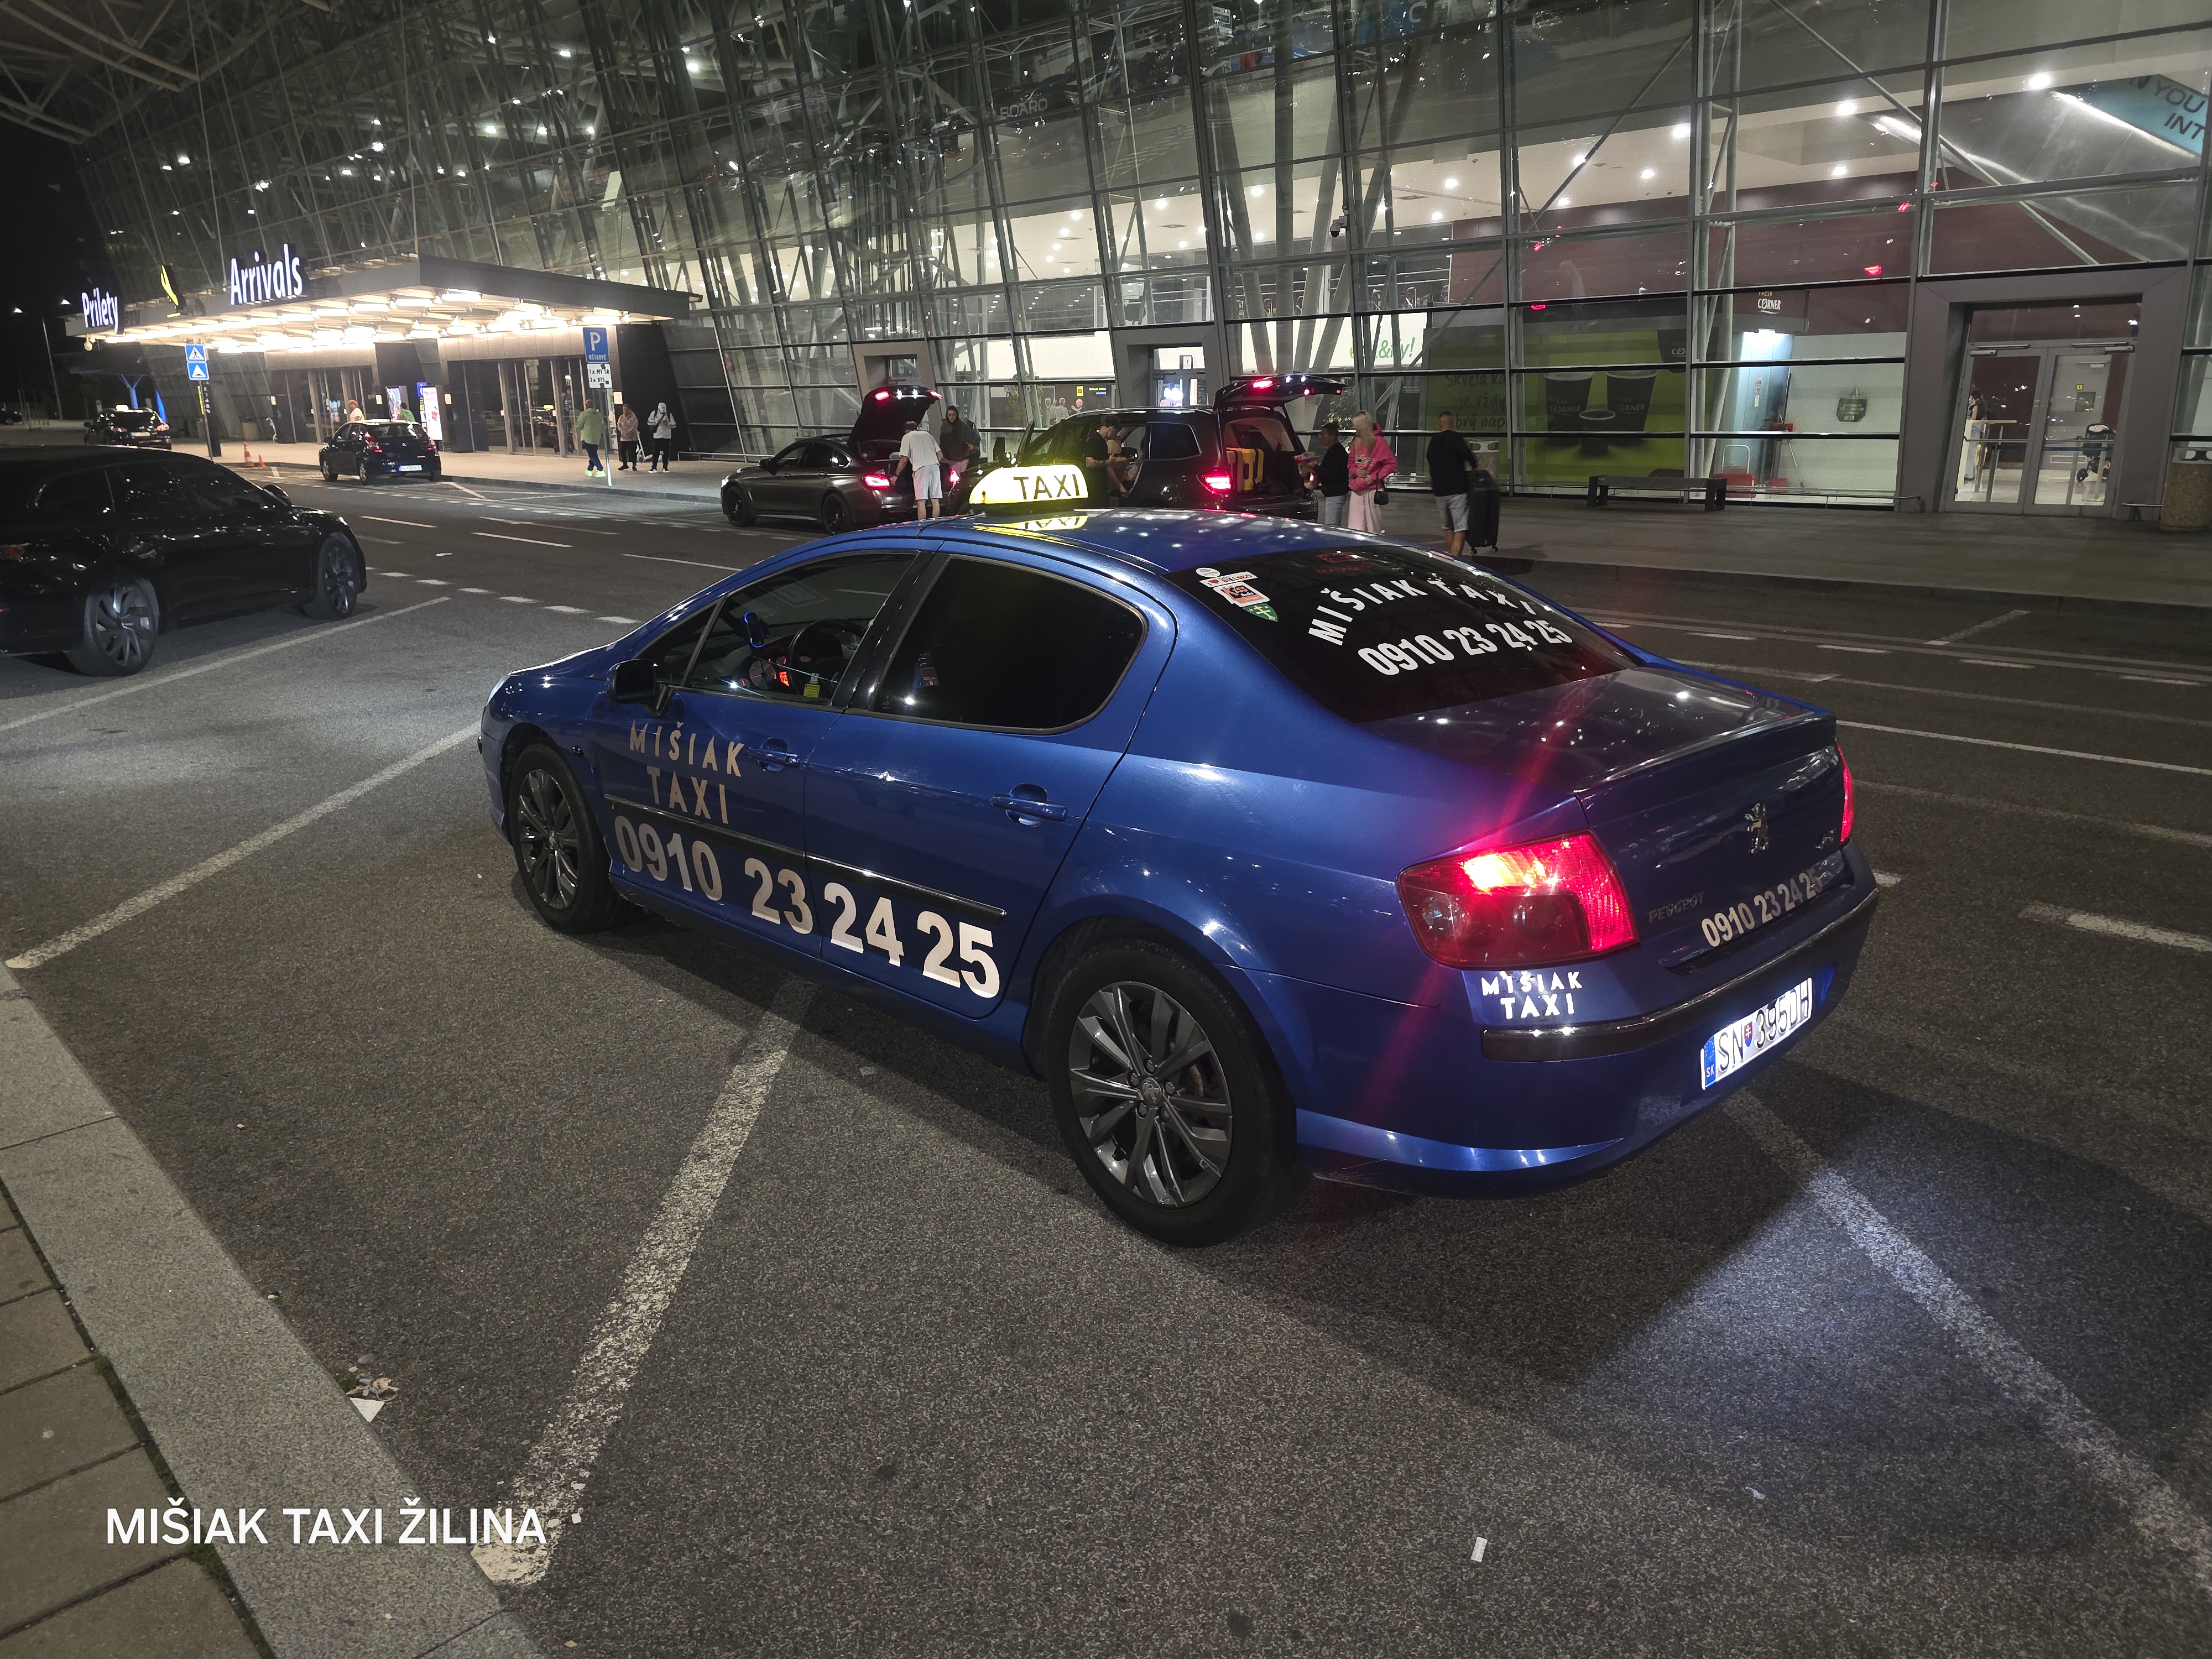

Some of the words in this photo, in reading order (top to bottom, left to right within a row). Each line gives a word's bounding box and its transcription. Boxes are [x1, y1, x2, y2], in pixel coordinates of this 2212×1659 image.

[230, 243, 303, 305] Arrivals
[81, 287, 119, 335] Prilety
[589, 332, 601, 351] P
[1013, 474, 1080, 499] TAXI
[1308, 580, 1428, 646] MIŠIAK
[1427, 579, 1537, 615] TAXI
[1358, 634, 1454, 675] 0910
[1443, 627, 1498, 656] 23
[1485, 622, 1538, 648] 24
[1524, 619, 1573, 644] 25
[629, 719, 745, 777] MIŠIAK
[646, 765, 728, 824] TAXI
[614, 816, 722, 901] 0910
[744, 858, 813, 935] 23
[824, 882, 905, 967] 24
[917, 911, 1000, 998] 25
[1648, 891, 1705, 924] PEUGEOT
[1701, 902, 1755, 947] 0910
[1754, 890, 1782, 924] 23
[1777, 878, 1804, 911] 24
[1798, 867, 1824, 900] 25
[1481, 971, 1583, 995] MIŠIAK
[1500, 993, 1580, 1020] TAXI
[1706, 1063, 1714, 1078] SK
[1718, 1021, 1744, 1072] SN
